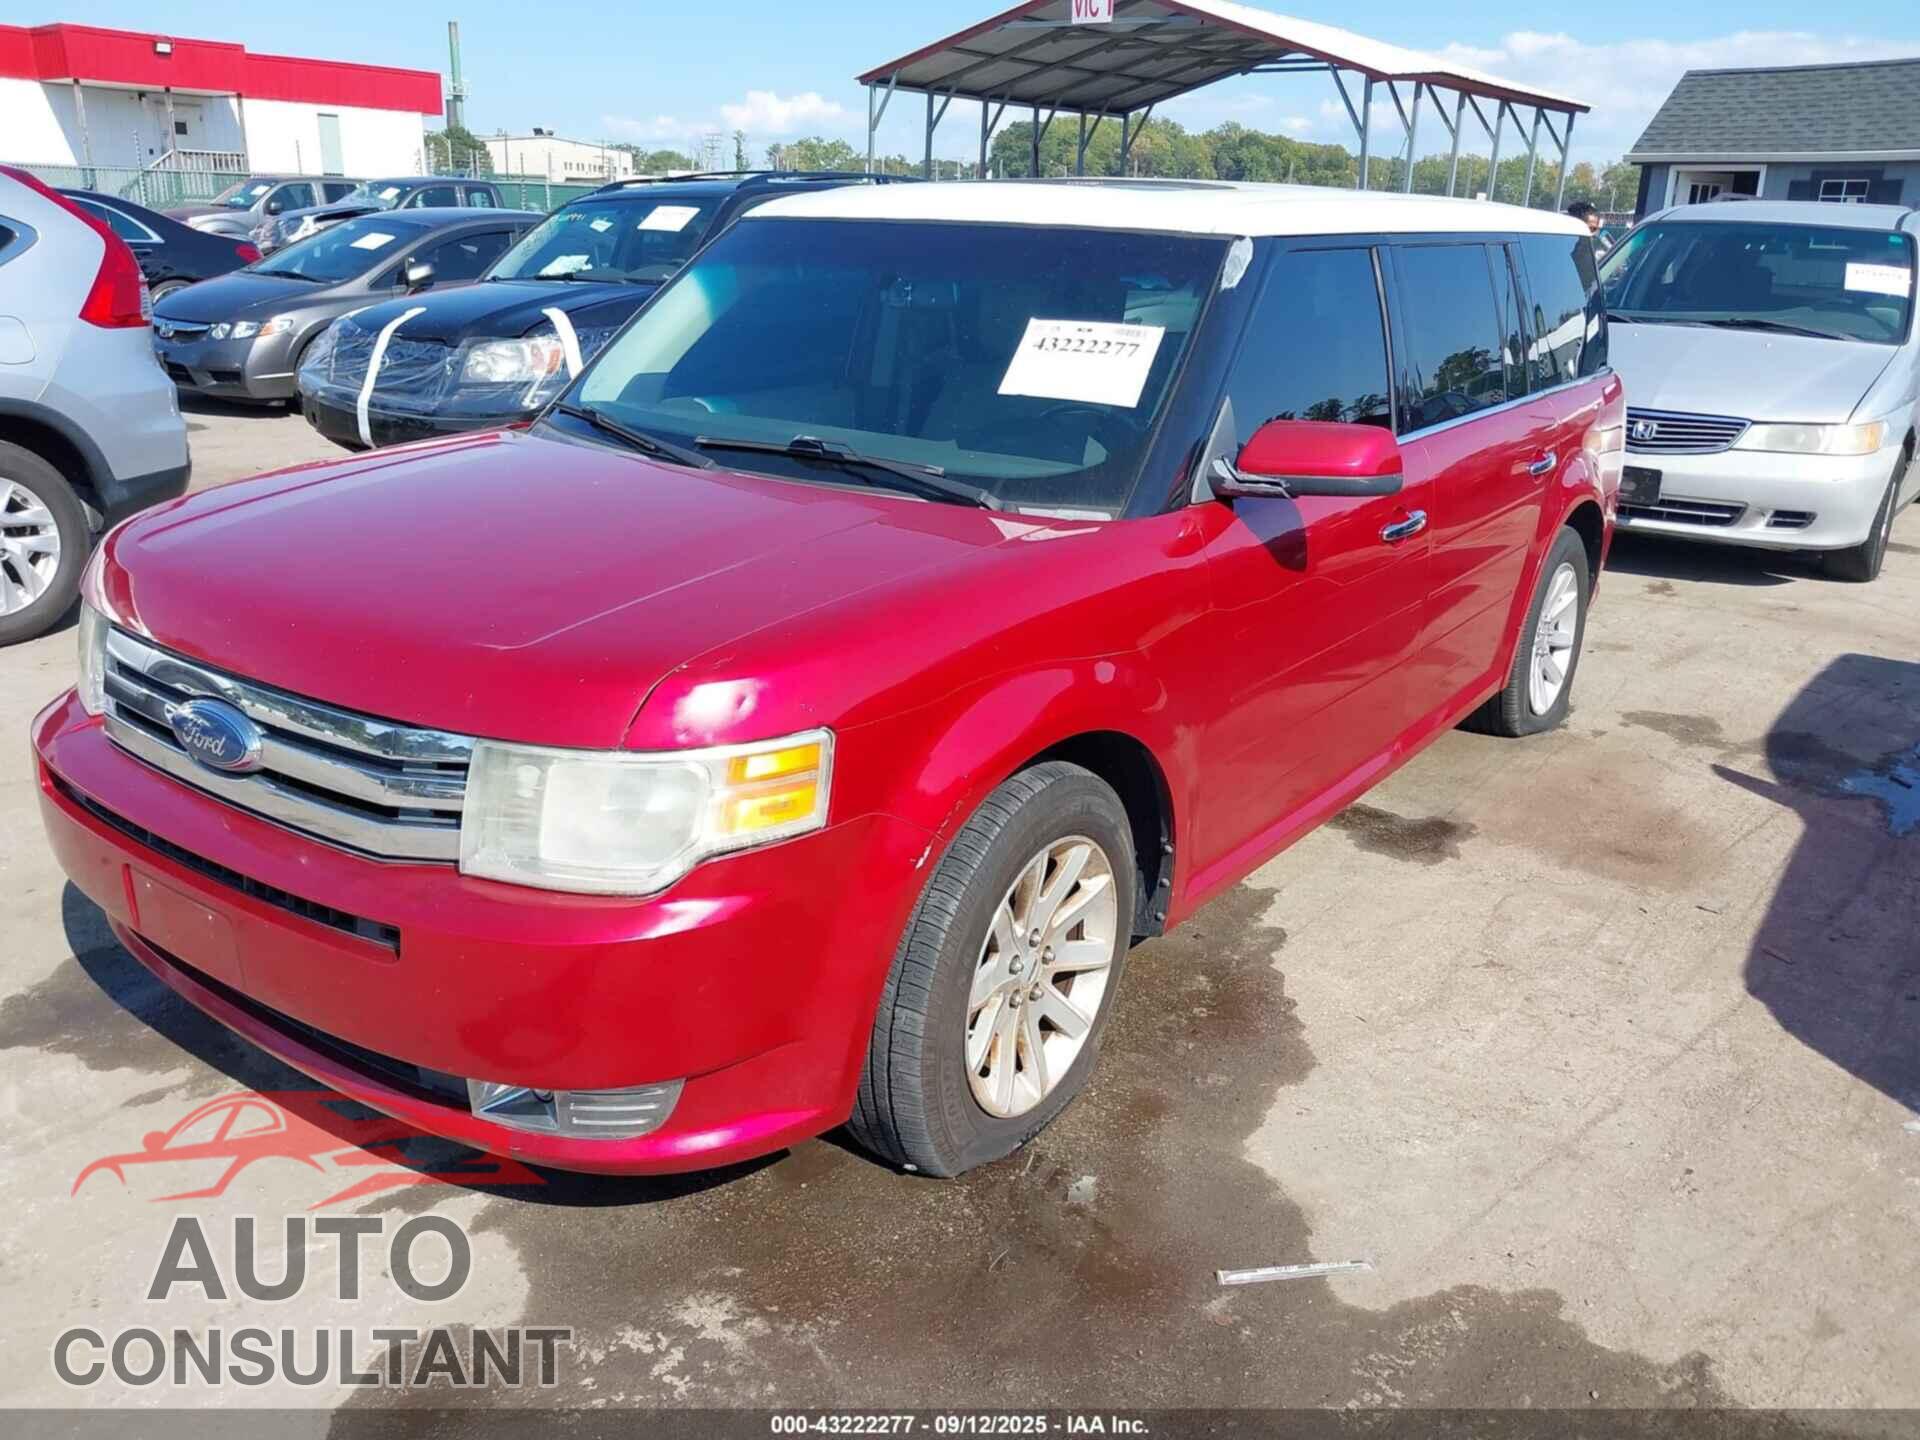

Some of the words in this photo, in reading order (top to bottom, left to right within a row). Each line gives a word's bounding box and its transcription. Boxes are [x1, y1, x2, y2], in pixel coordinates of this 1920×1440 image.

[1075, 0, 1099, 17] VIC
[1032, 336, 1141, 358] 43222277
[182, 718, 226, 757] Ford
